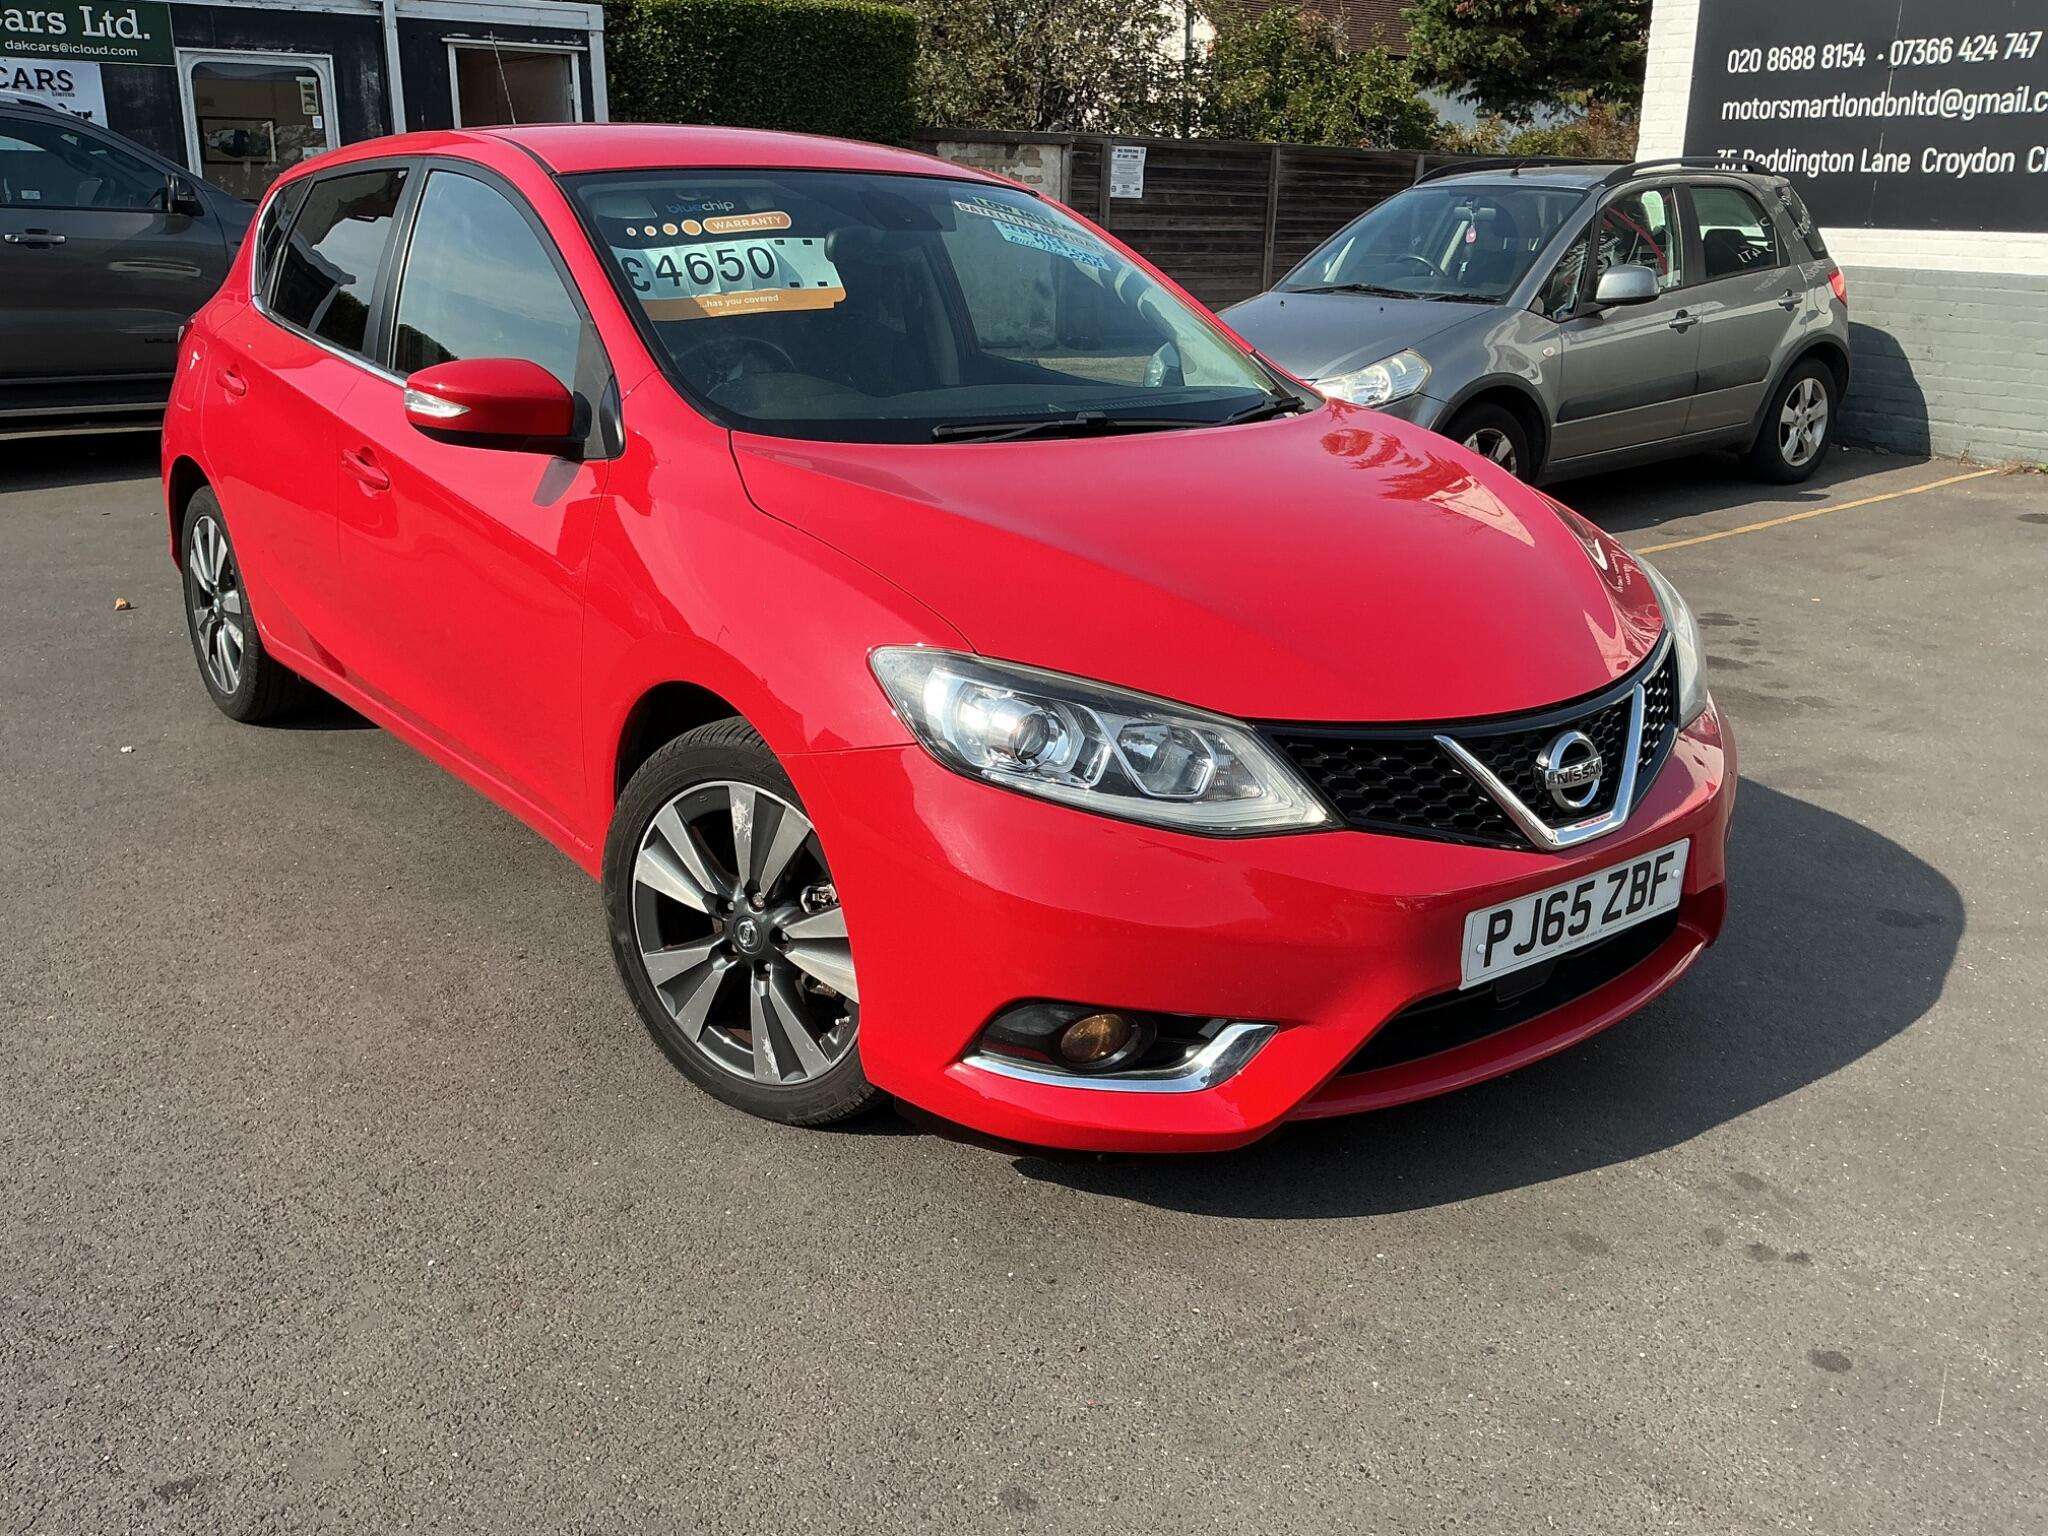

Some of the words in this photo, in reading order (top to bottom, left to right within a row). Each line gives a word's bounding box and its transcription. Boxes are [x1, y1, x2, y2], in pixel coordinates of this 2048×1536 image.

[0, 8, 67, 35] ars
[79, 5, 151, 39] Ltd.
[4, 40, 138, 57] dakcars@icloud.com
[1727, 48, 1762, 73] 020
[1767, 45, 1816, 71] 8688
[1821, 42, 1866, 69] 8154
[1890, 37, 1953, 67] 07366
[1958, 34, 1999, 62] 424
[2003, 31, 2043, 60] 747
[1861, 147, 1911, 174] Lane
[1921, 146, 2016, 179] Croydon
[712, 215, 782, 230] WARRANTY
[620, 246, 776, 292] £4650
[725, 297, 742, 307] you
[743, 294, 779, 305] covered
[1556, 760, 1602, 785] NISSAN
[1482, 880, 1596, 968] PJ65
[1600, 851, 1675, 925] ZBF
